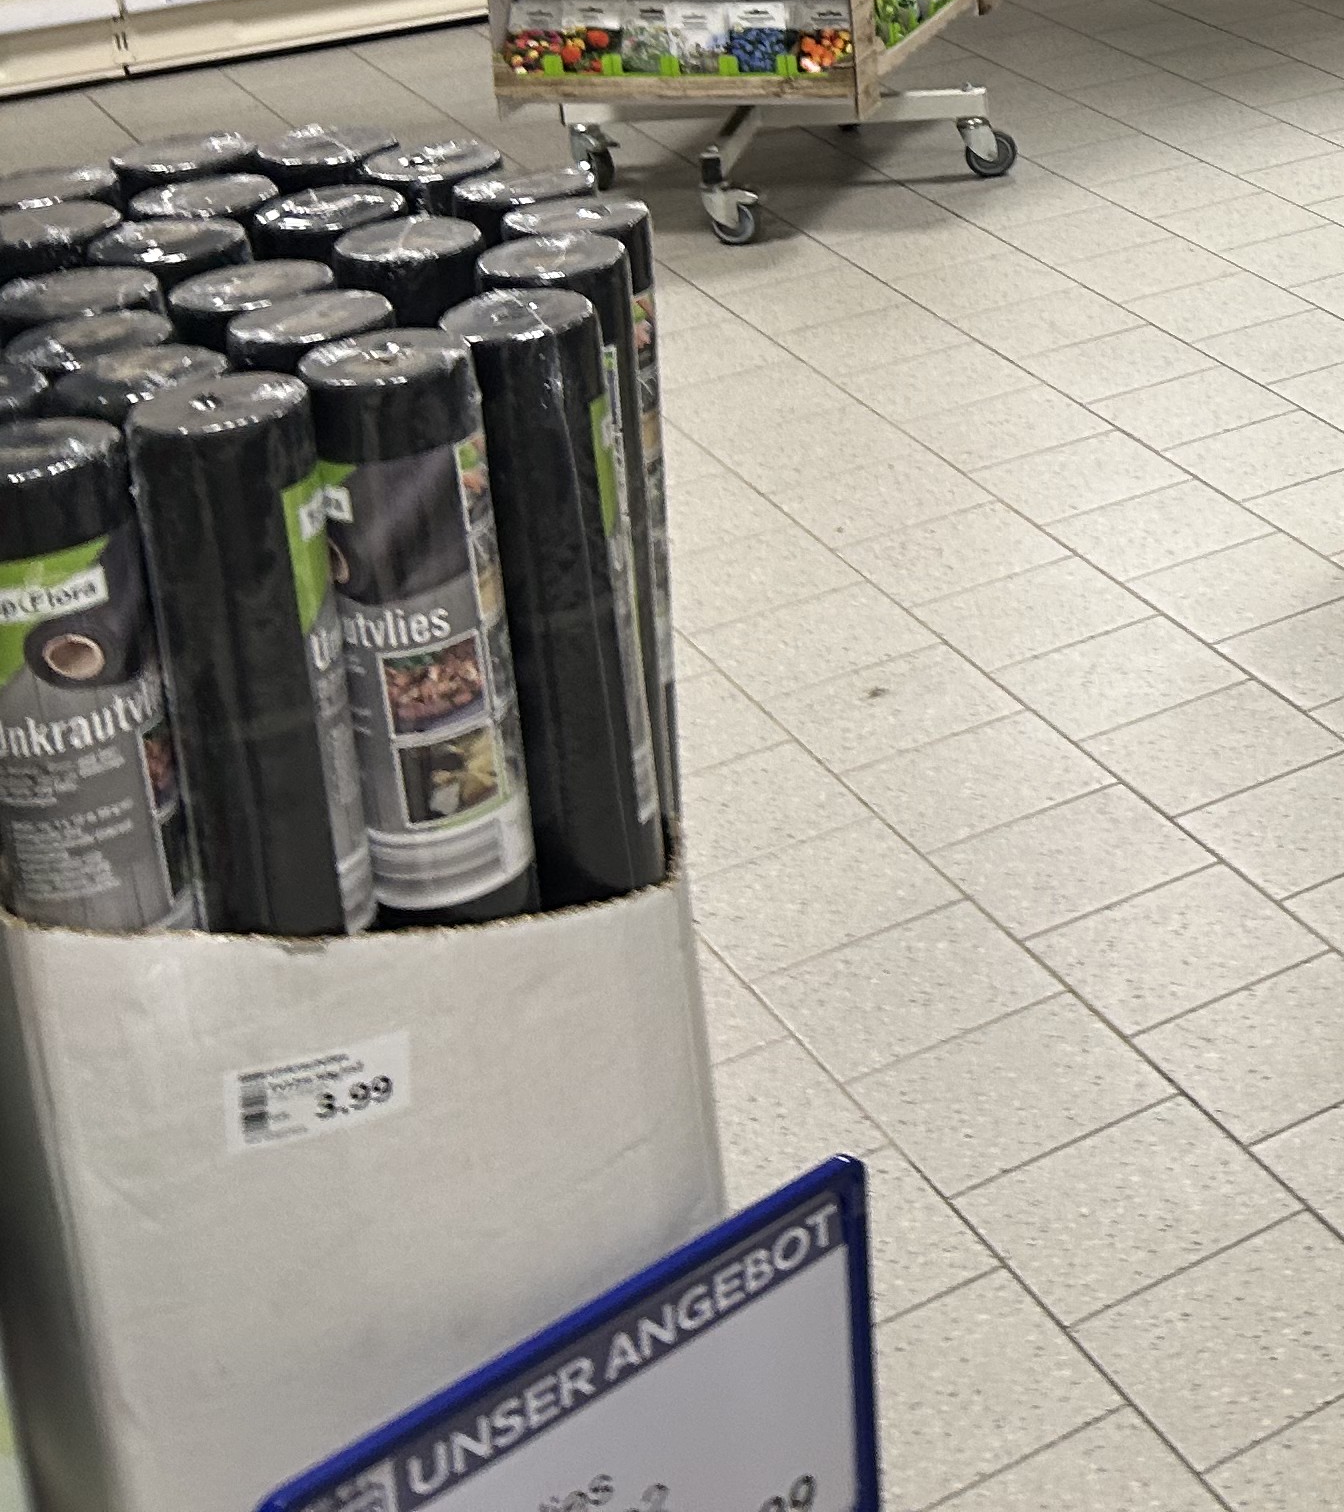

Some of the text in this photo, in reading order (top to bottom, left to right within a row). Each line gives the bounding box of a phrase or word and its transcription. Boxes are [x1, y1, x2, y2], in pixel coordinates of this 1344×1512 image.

[314, 1074, 394, 1121] 3.99
[407, 1203, 839, 1495] UNSER ANGEBOT
